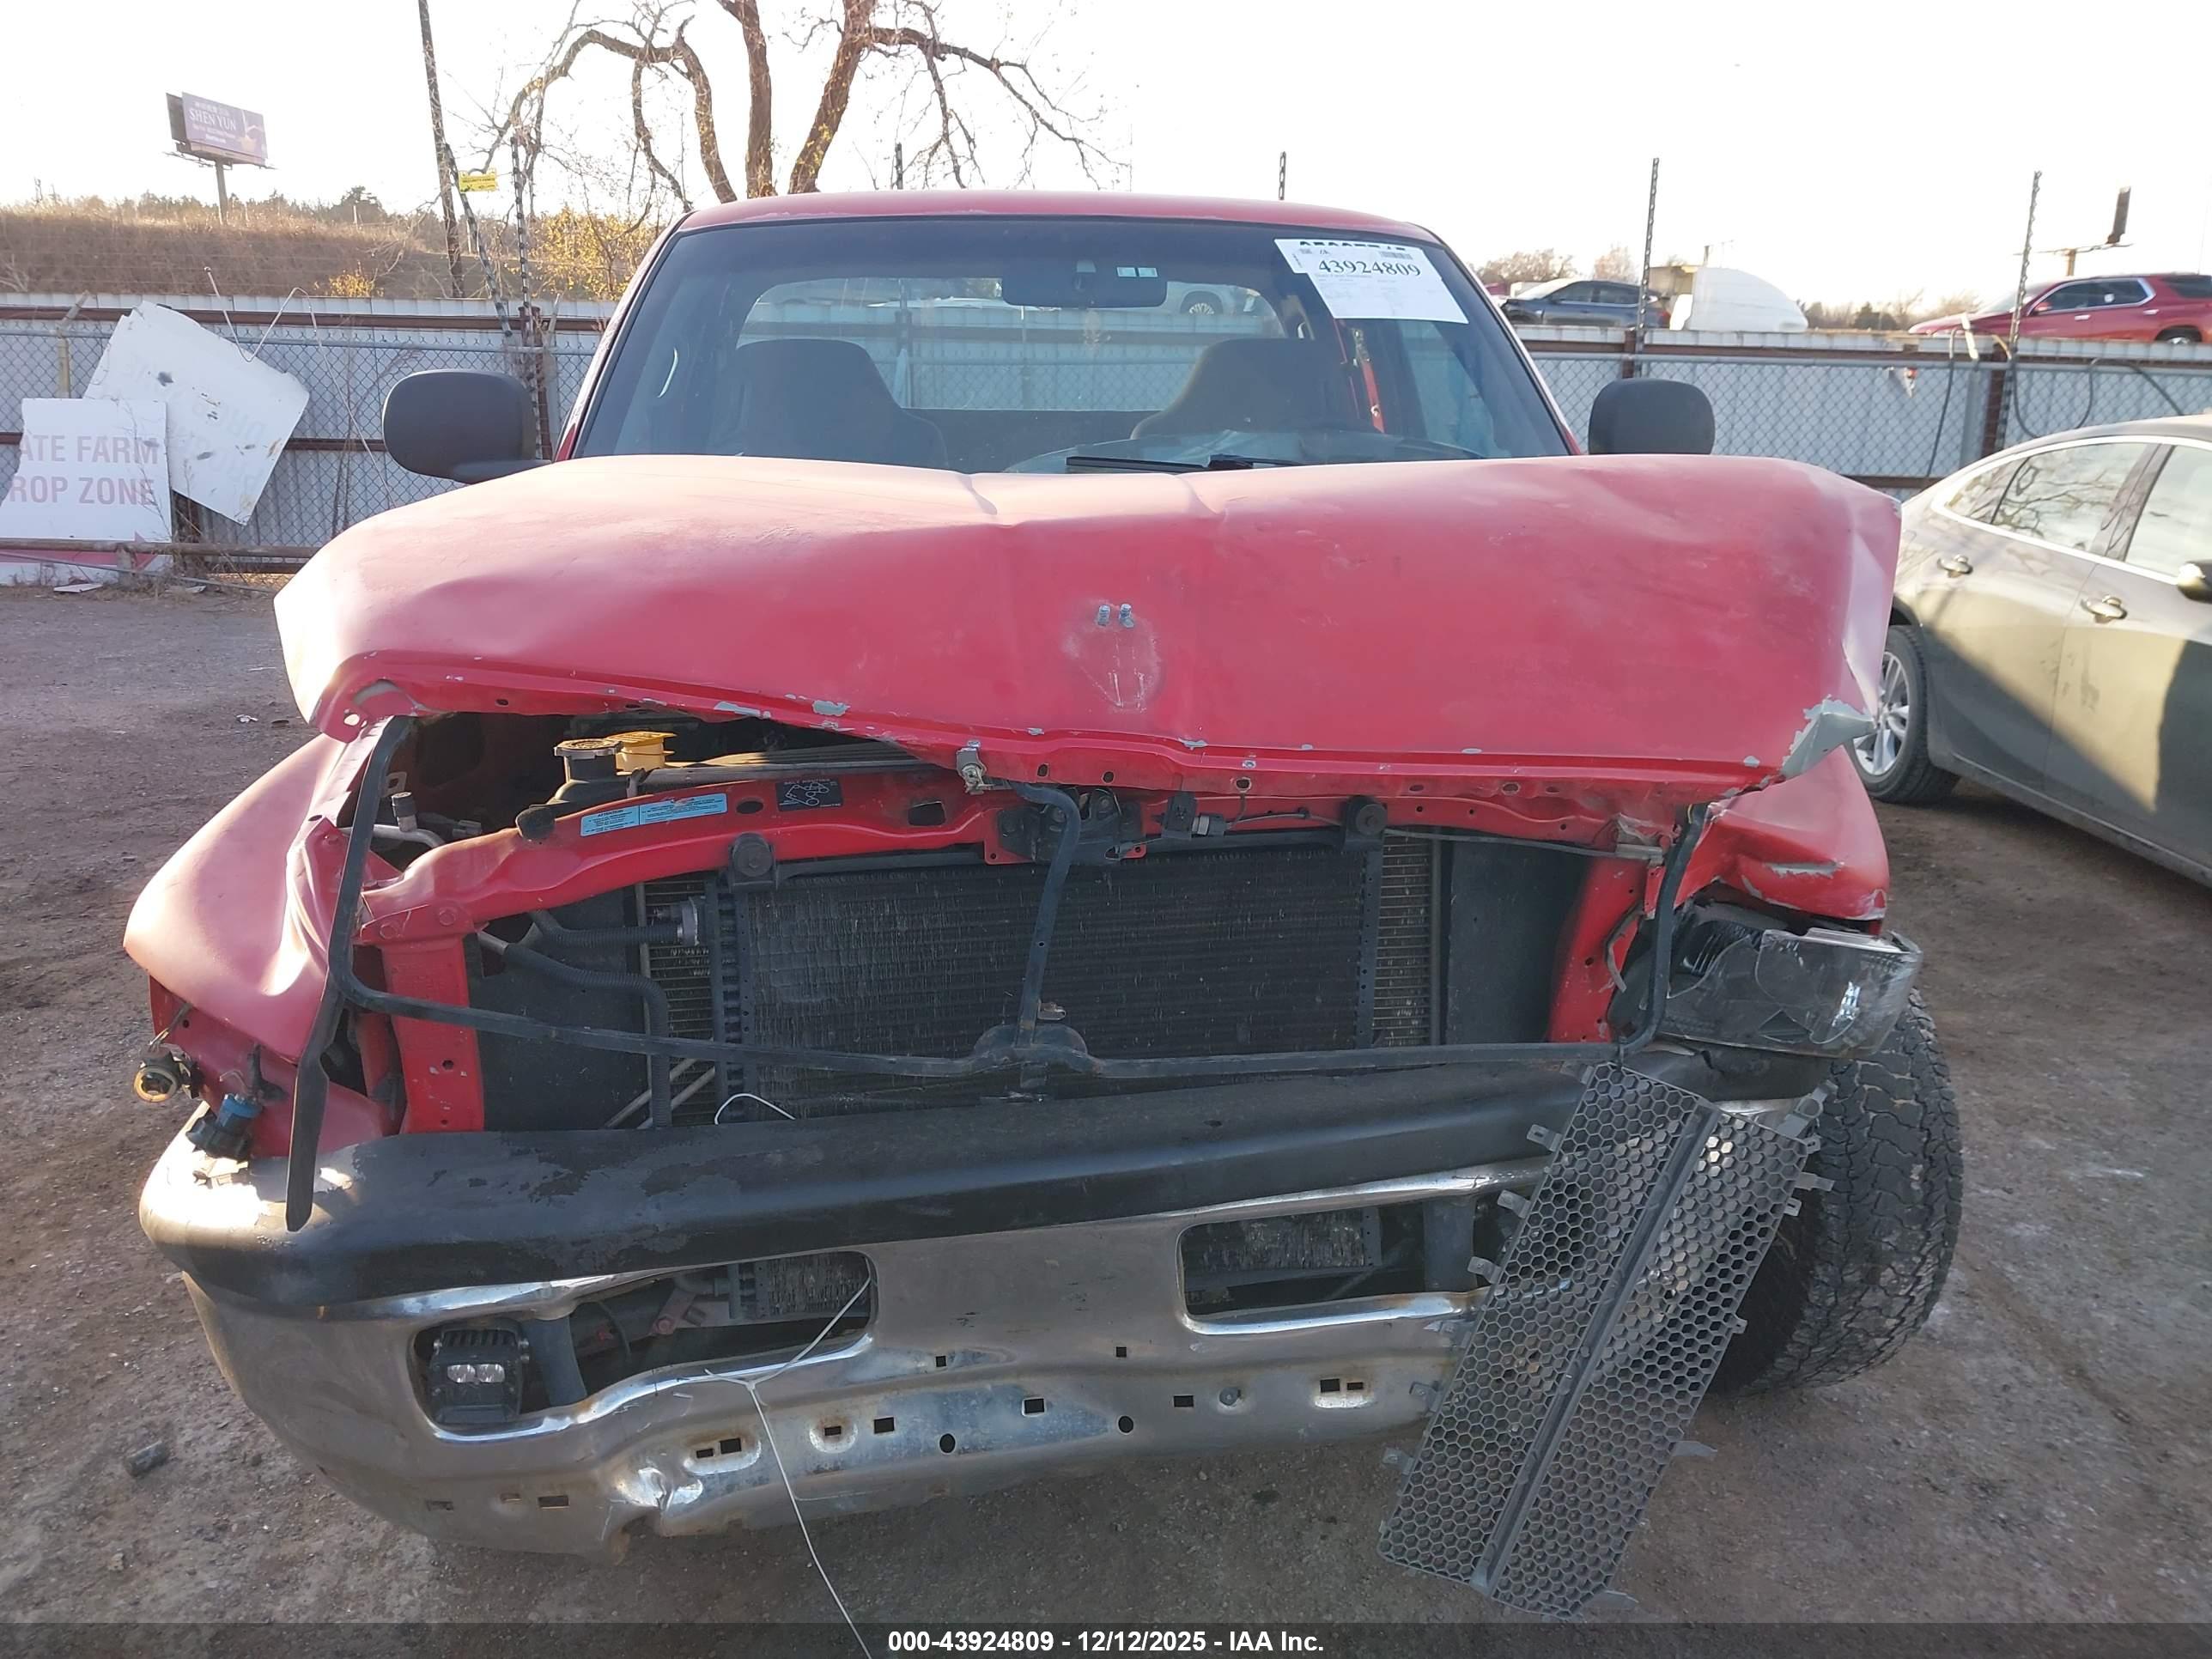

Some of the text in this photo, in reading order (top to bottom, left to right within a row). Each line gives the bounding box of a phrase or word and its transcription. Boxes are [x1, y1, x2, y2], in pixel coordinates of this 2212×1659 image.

[189, 108, 216, 125] SHEN
[216, 114, 237, 131] YUN
[1319, 259, 1421, 276] 43924809
[77, 436, 158, 465] FARM
[79, 477, 156, 506] ZONE
